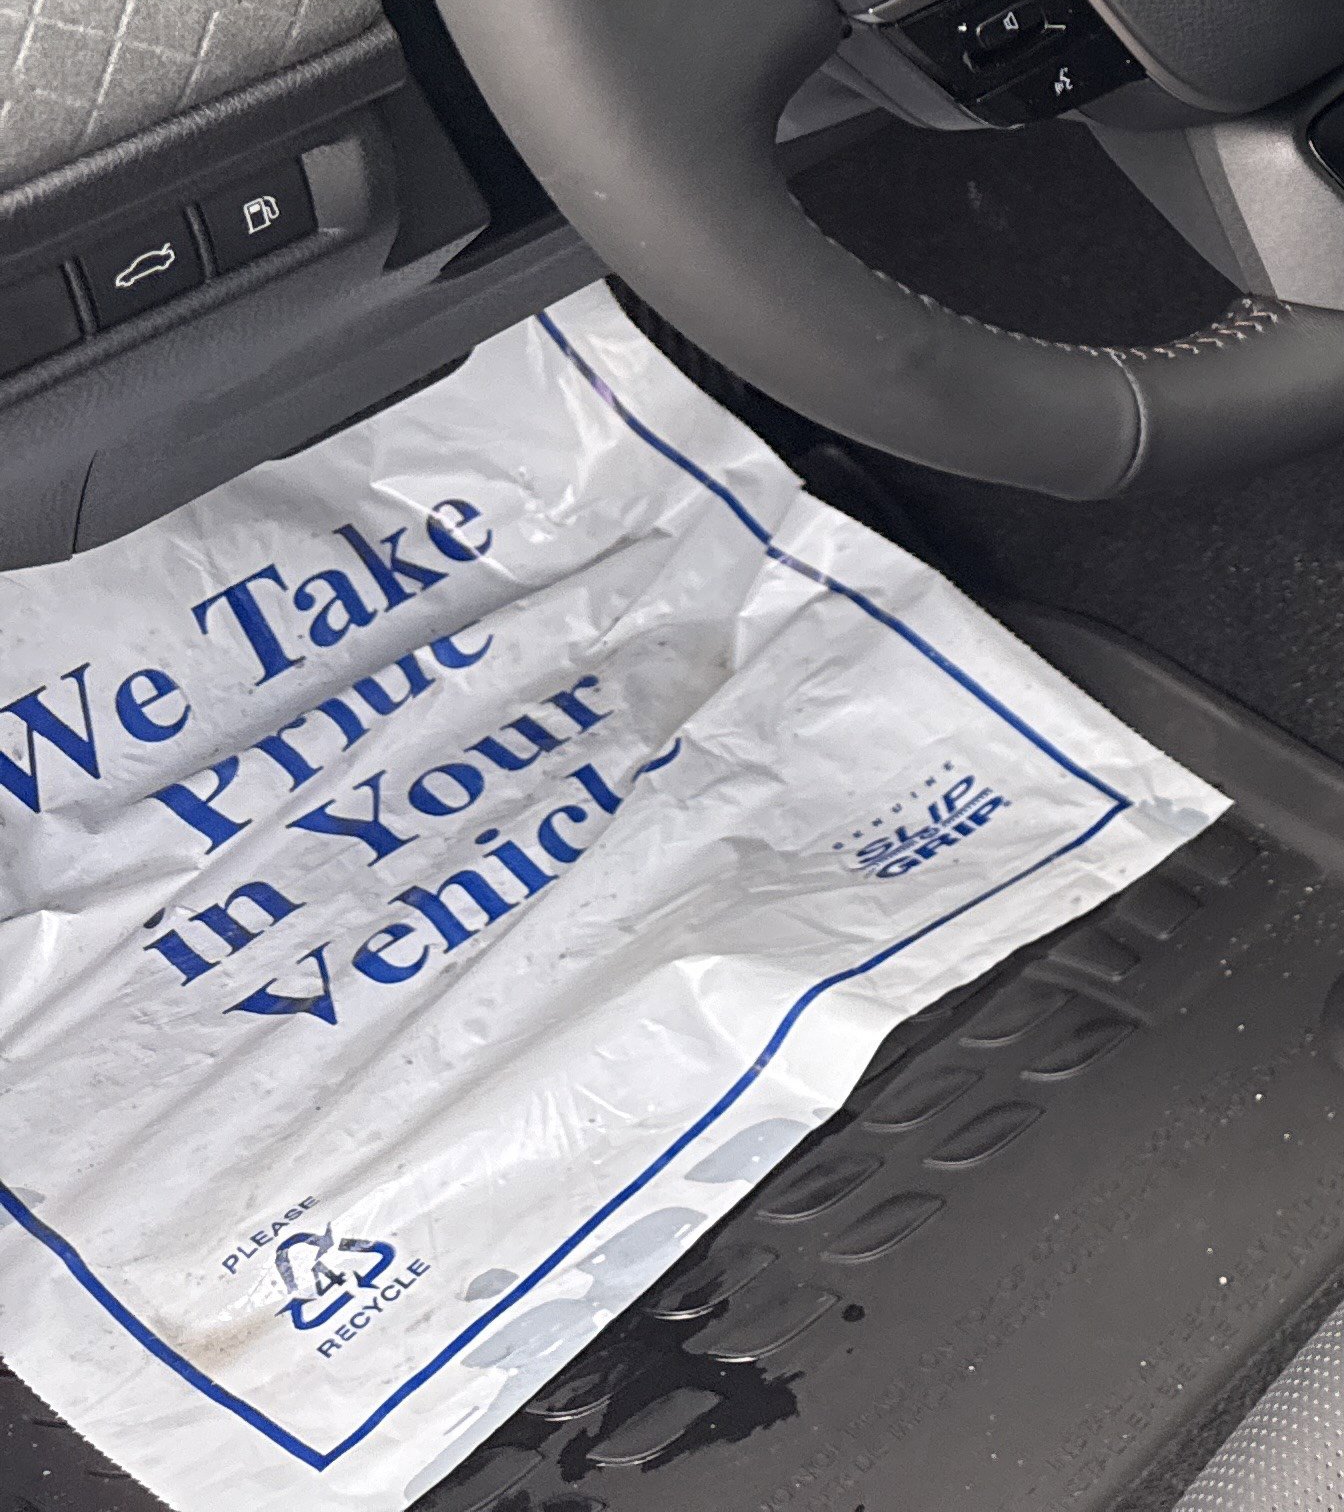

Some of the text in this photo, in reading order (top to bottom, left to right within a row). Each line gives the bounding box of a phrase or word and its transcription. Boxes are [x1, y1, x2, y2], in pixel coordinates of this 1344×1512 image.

[0, 498, 494, 814] We Take
[143, 674, 615, 987] in Your
[832, 760, 955, 851] GENUINE
[856, 774, 976, 865] SLIP
[875, 795, 1006, 879] GRIP
[221, 1195, 321, 1276] PLEASE
[311, 1259, 346, 1297] 4
[315, 1257, 432, 1360] RECYCLE
